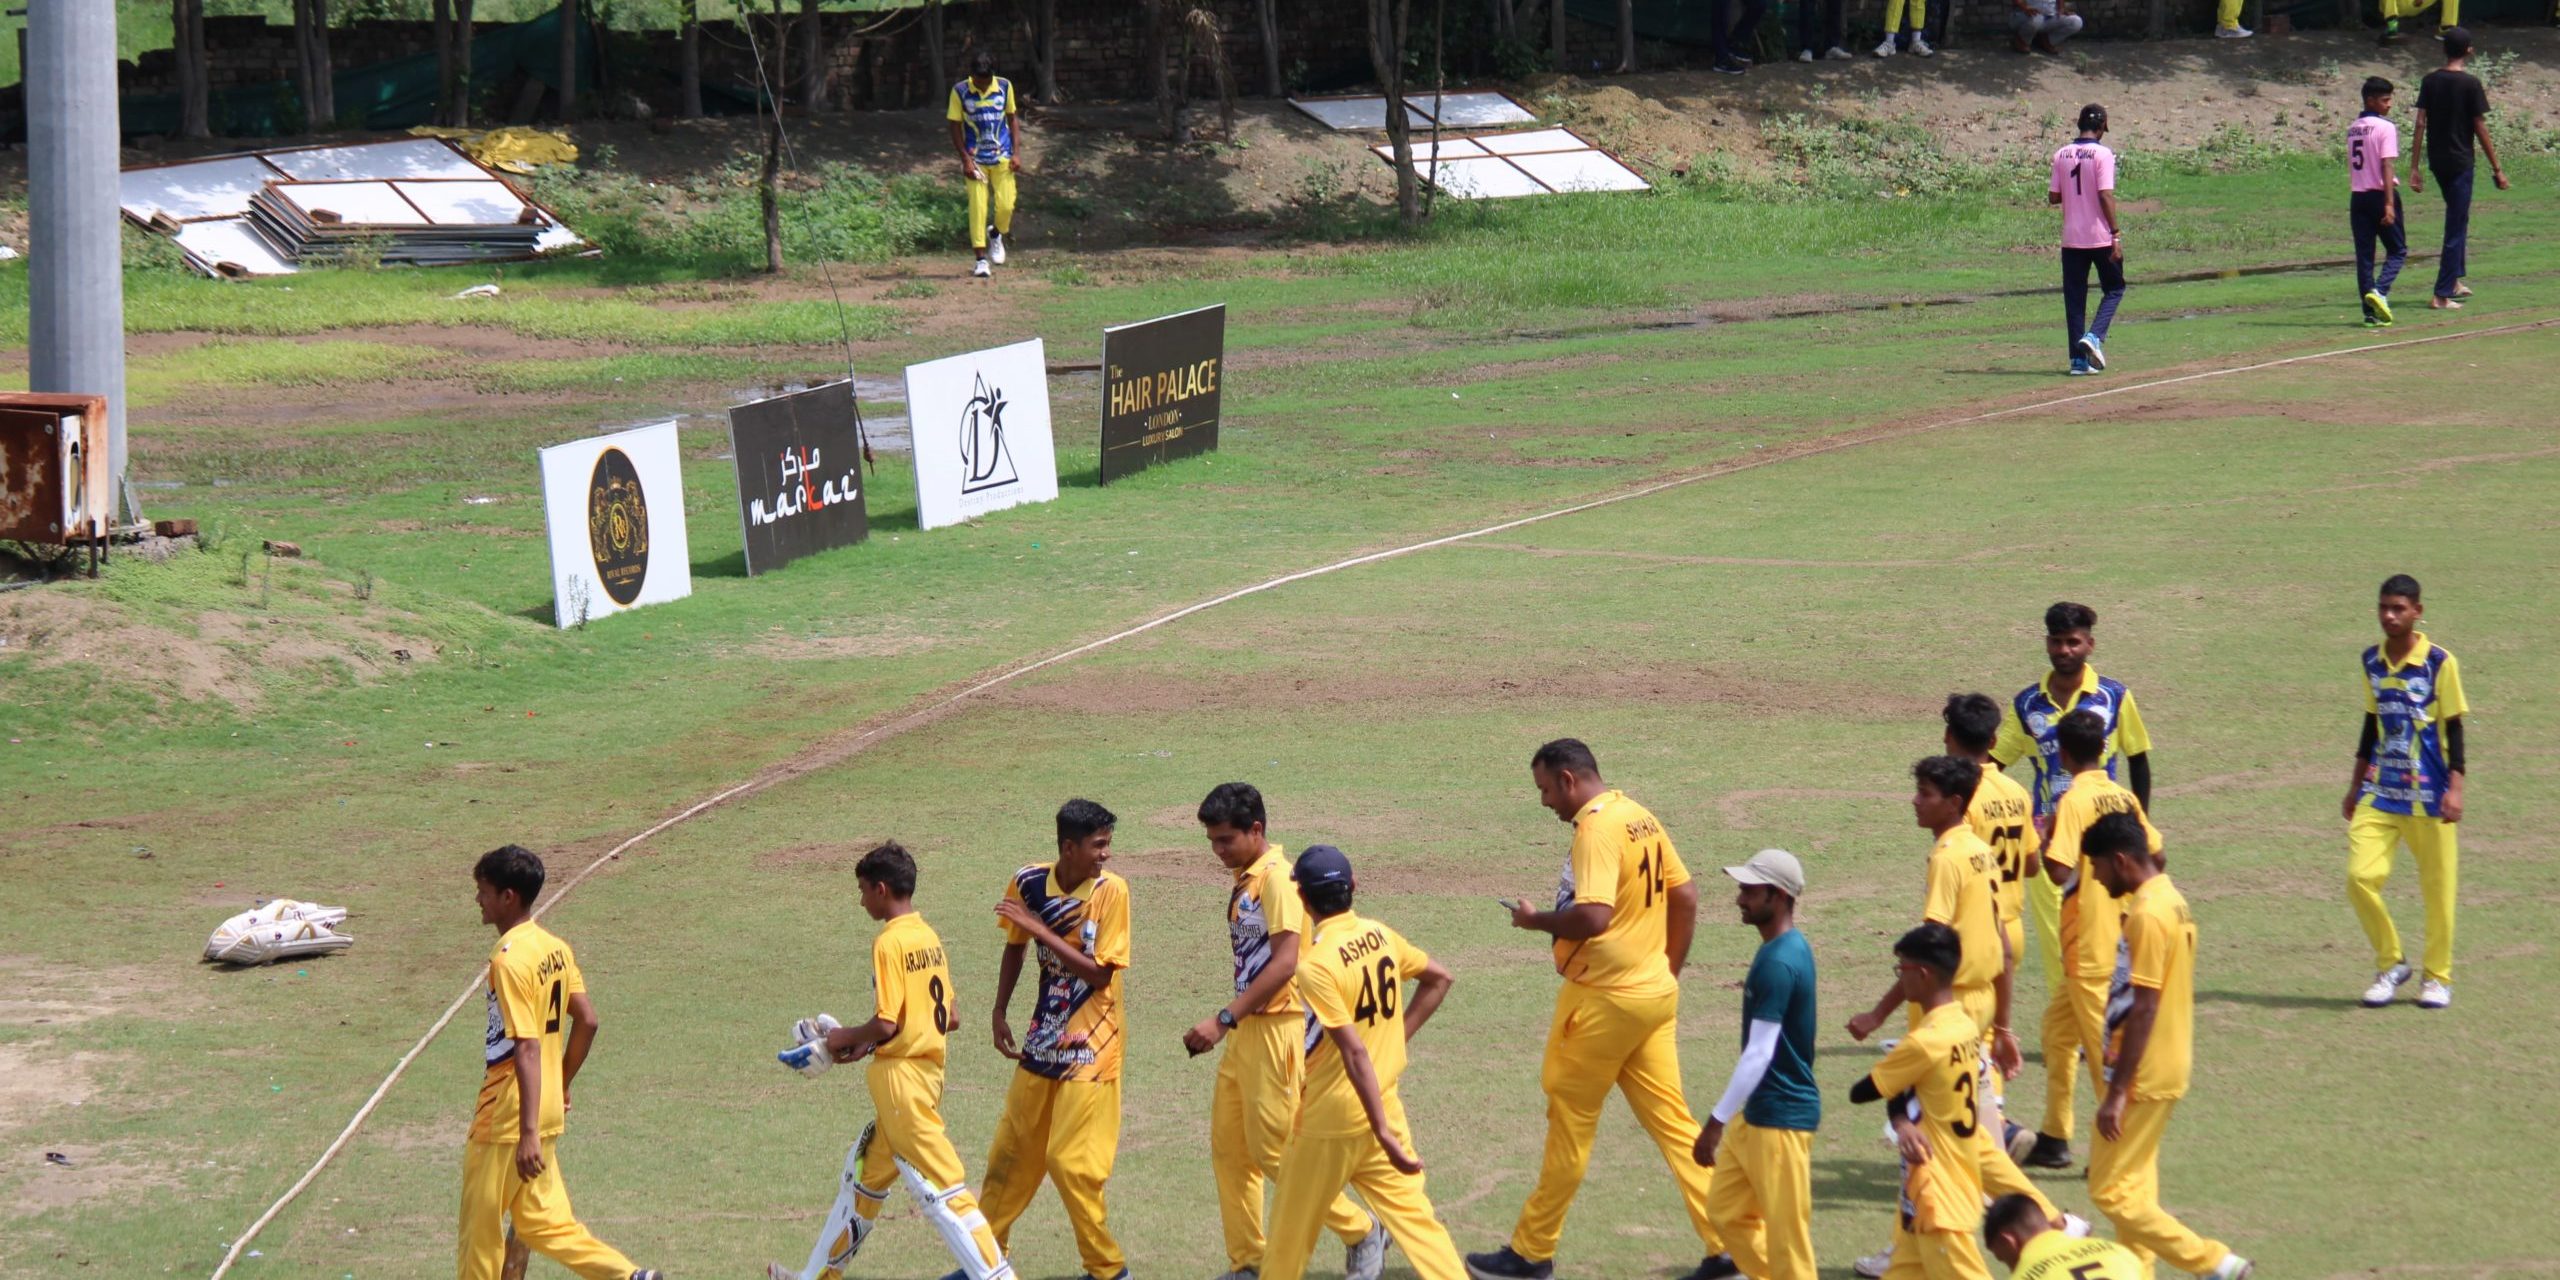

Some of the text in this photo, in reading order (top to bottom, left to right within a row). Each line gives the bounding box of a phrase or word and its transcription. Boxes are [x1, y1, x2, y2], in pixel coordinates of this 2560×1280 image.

[2352, 140, 2364, 170] 5
[2070, 162, 2081, 195] 1
[1110, 365, 1123, 379] The
[1111, 358, 1217, 417] HAIR PALACE
[1142, 427, 1184, 447] LUXURY SALON
[1148, 409, 1180, 430] LONDON
[1638, 841, 1666, 908] 14
[905, 948, 930, 974] ARJUN
[1338, 928, 1388, 968] ASHOK
[929, 974, 947, 1036] 8
[1354, 956, 1396, 1028] 46
[1951, 1071, 1977, 1138] 3
